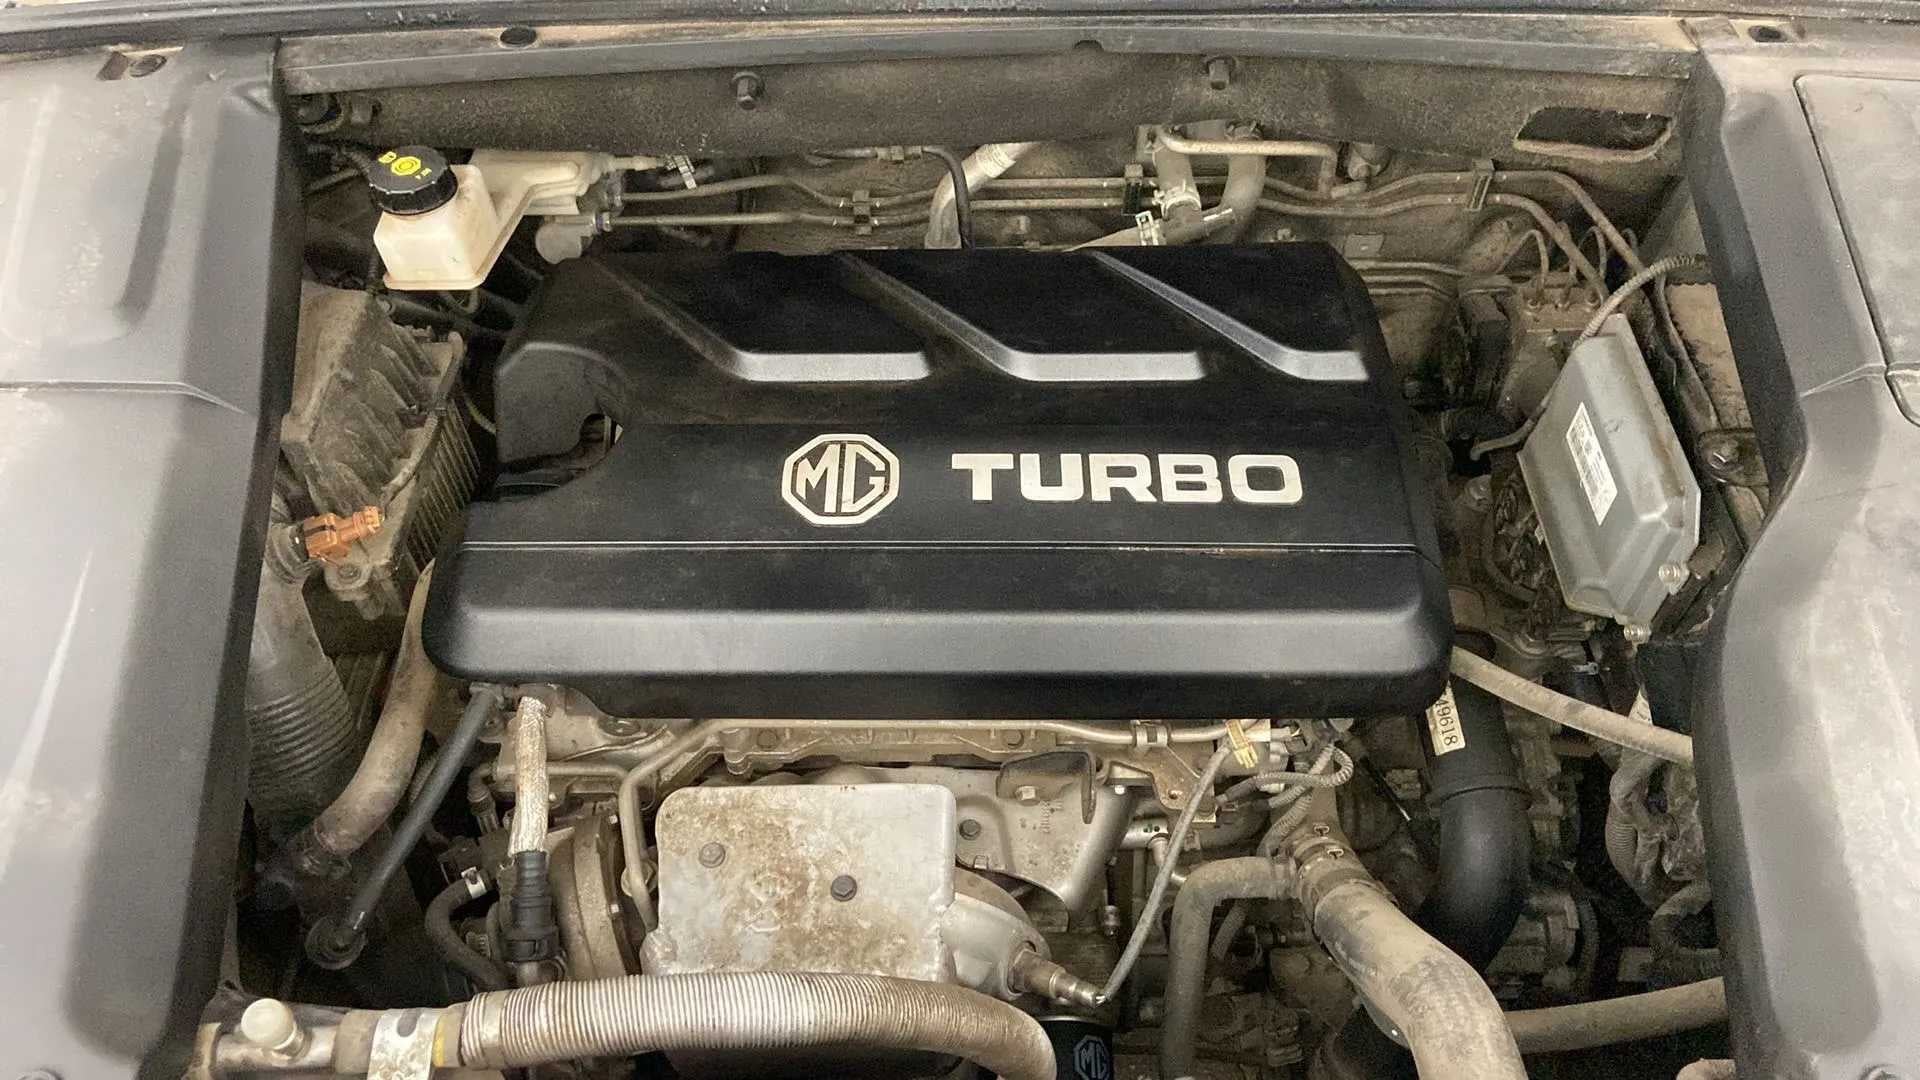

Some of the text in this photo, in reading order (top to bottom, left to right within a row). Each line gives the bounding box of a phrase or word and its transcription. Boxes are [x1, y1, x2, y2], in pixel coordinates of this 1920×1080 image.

[793, 440, 1303, 517] MG TURBO
[1078, 1040, 1107, 1080] MG
